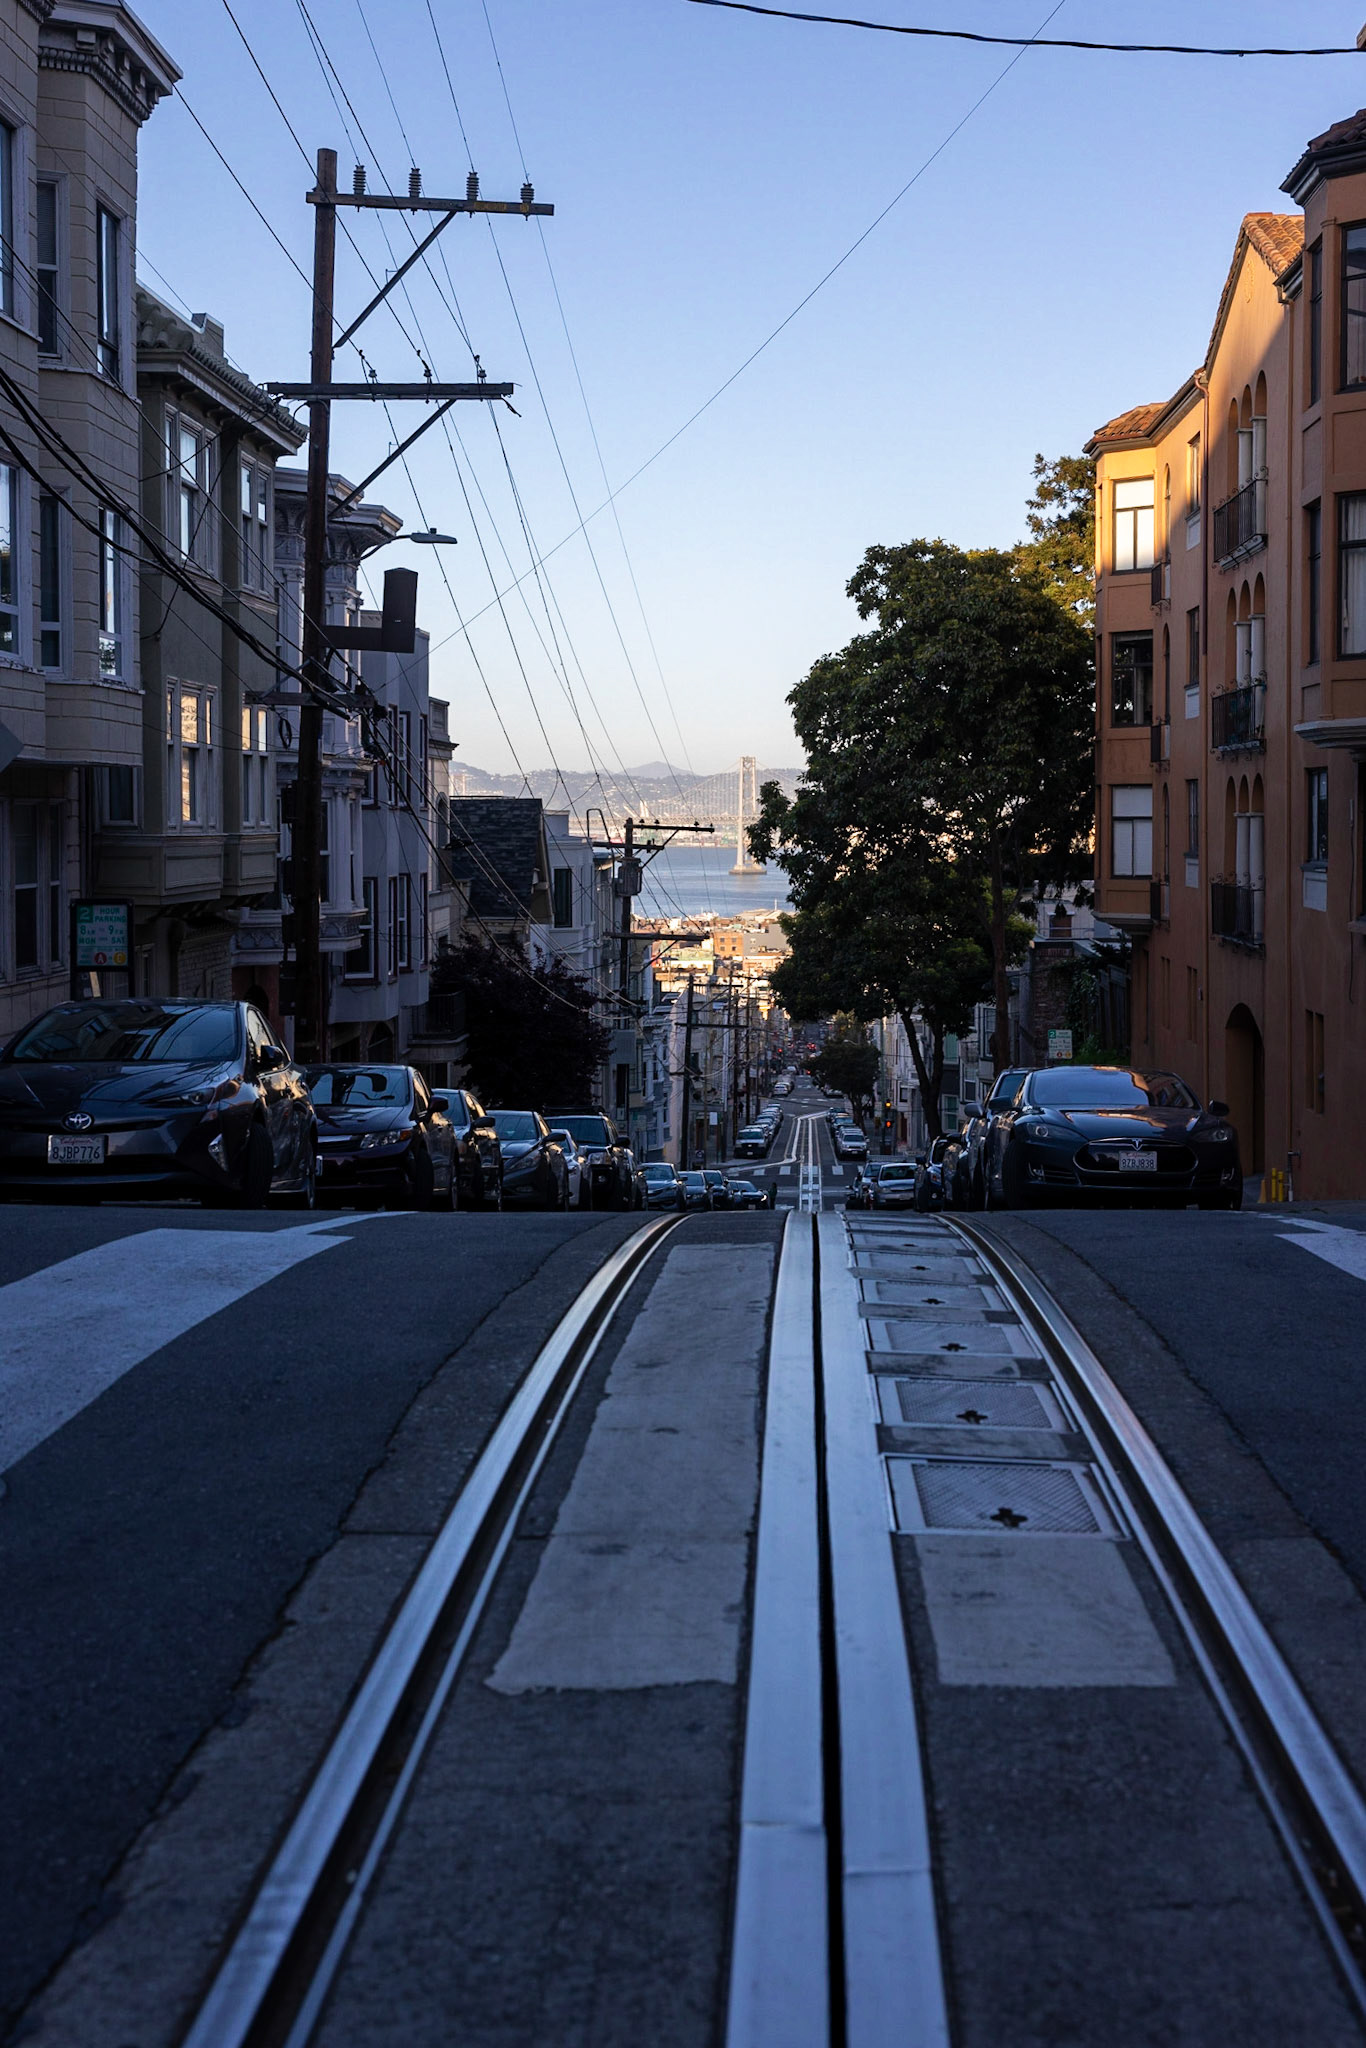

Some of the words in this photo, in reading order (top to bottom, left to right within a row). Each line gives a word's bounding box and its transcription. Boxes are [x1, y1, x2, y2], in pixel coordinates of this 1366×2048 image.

[79, 907, 89, 920] 2
[111, 936, 124, 944] SAT
[53, 1146, 100, 1159] 8JBP776
